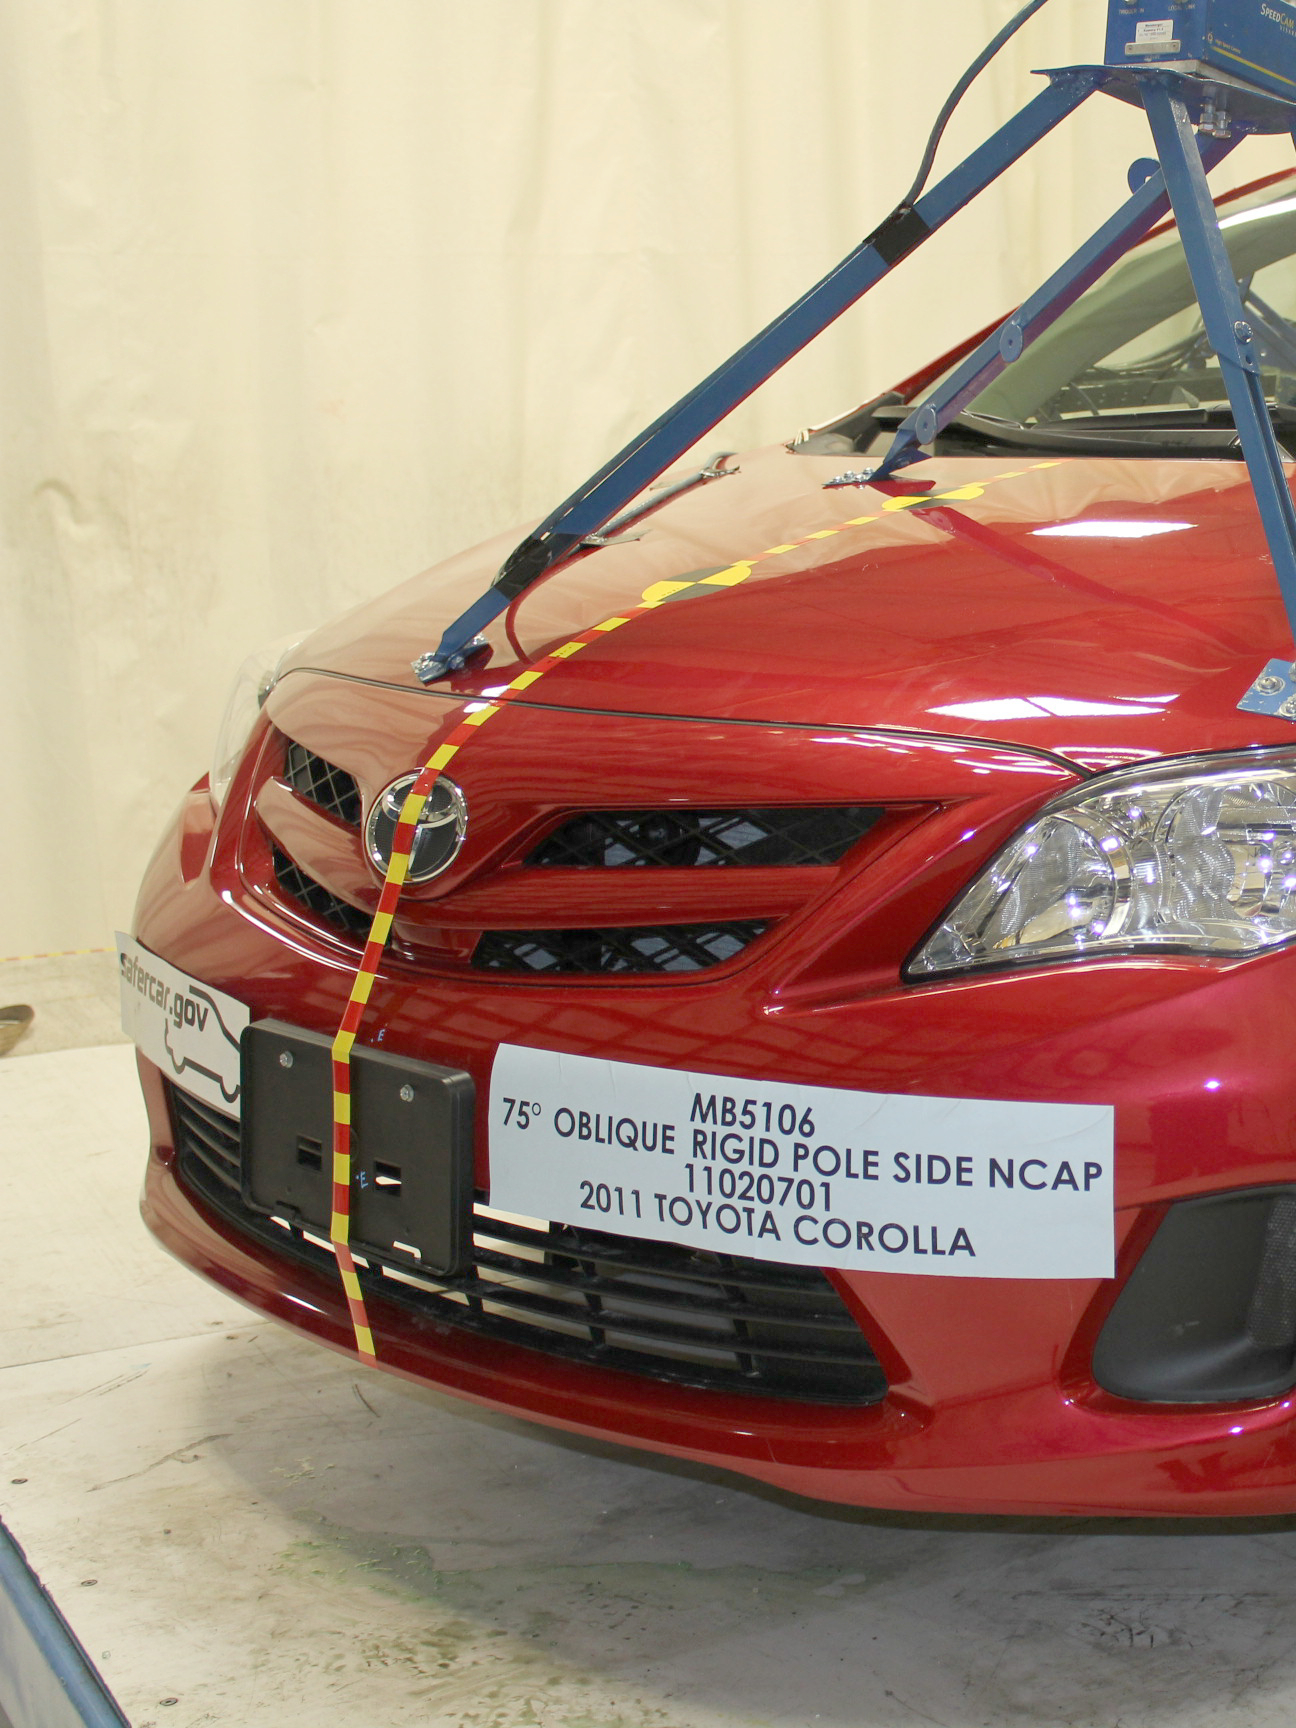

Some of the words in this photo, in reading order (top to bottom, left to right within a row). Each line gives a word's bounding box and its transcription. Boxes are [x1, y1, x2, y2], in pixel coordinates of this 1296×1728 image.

[120, 952, 209, 1032] safercar.gov
[553, 1107, 676, 1155] OBLIQUE
[692, 1128, 780, 1169] RIGID
[792, 1141, 880, 1181] POLE
[892, 1151, 974, 1187] SIDE
[988, 1157, 1103, 1192] NCAP
[690, 1092, 815, 1138] MB5106
[579, 1180, 642, 1219] 2011
[653, 1192, 782, 1242] TOYOTA
[792, 1214, 977, 1258] COROLLA
[684, 1162, 831, 1212] 11020701
